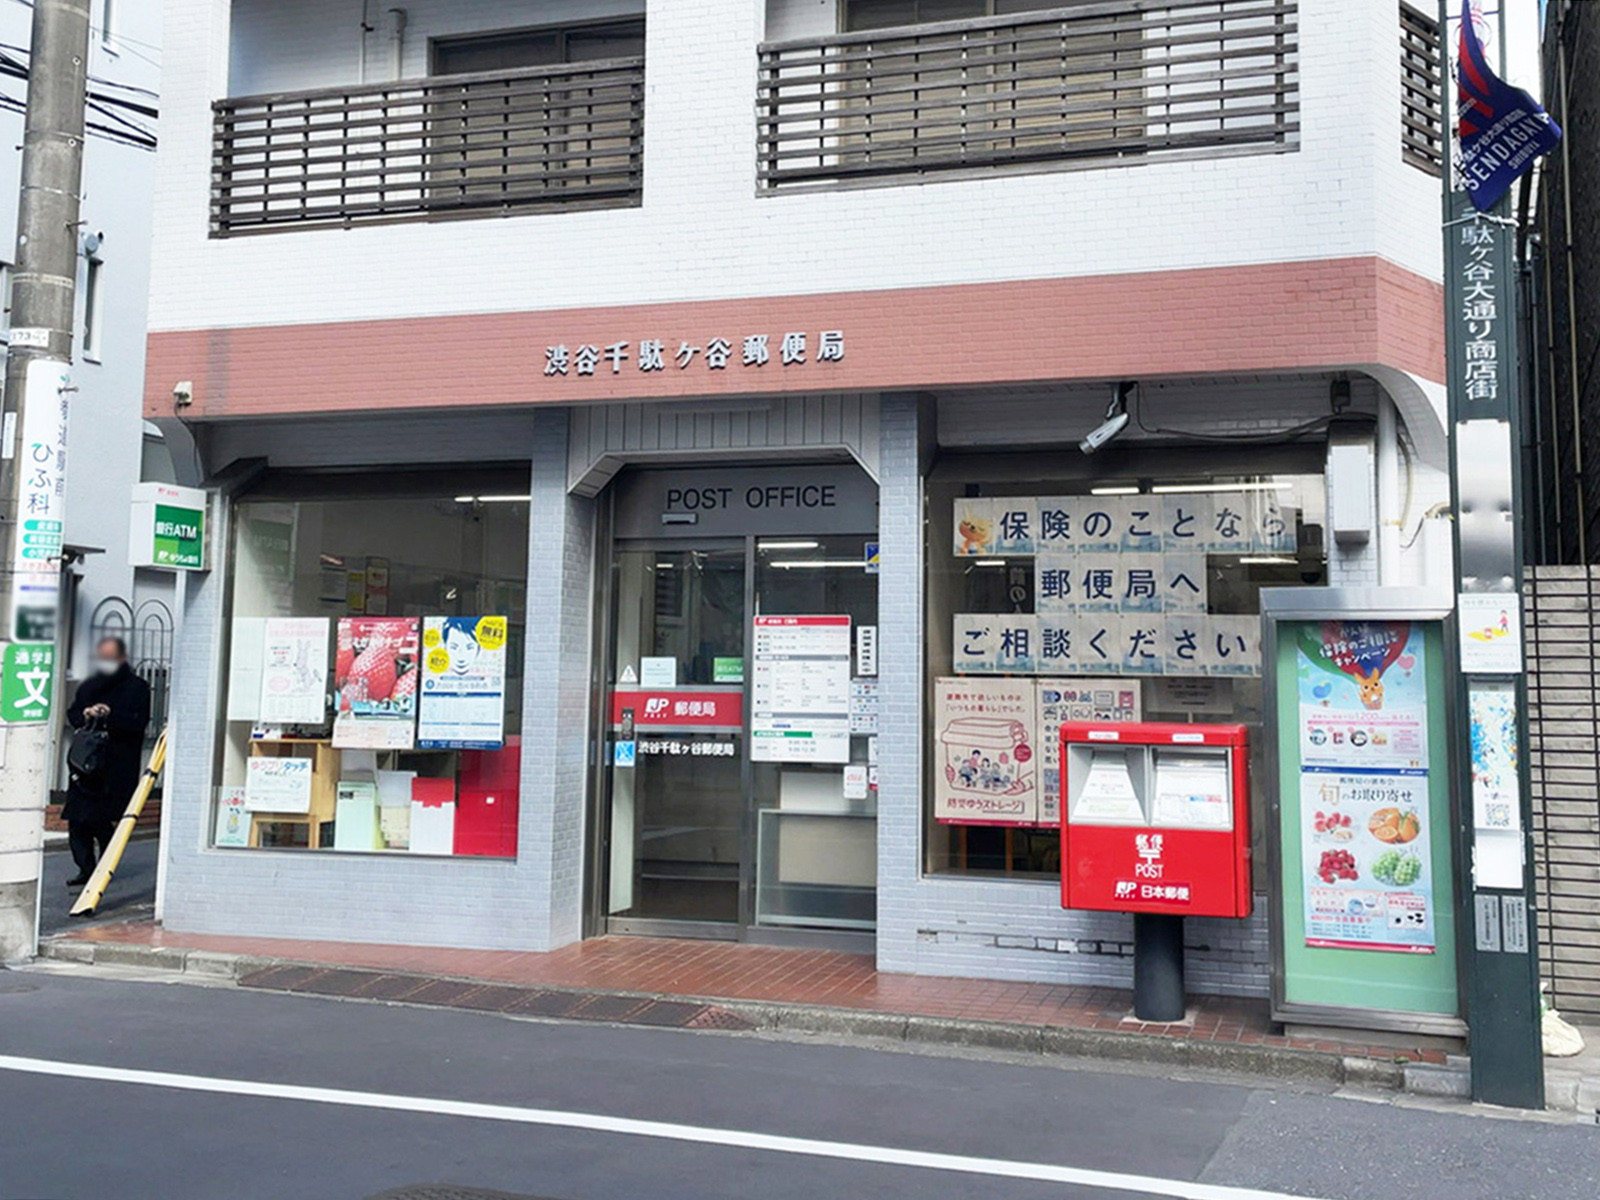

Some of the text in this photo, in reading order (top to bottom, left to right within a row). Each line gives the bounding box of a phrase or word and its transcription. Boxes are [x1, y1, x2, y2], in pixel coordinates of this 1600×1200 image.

[667, 485, 836, 510] POST OFFICE
[999, 506, 1286, 541] 保険のことなら
[1040, 568, 1201, 600] 郵便局へ
[962, 628, 1247, 660] ご相談ください
[674, 701, 716, 716] 郵便局
[1135, 834, 1163, 851] 郵便
[1135, 863, 1163, 878] POST
[1141, 885, 1189, 901] 日本郵便
